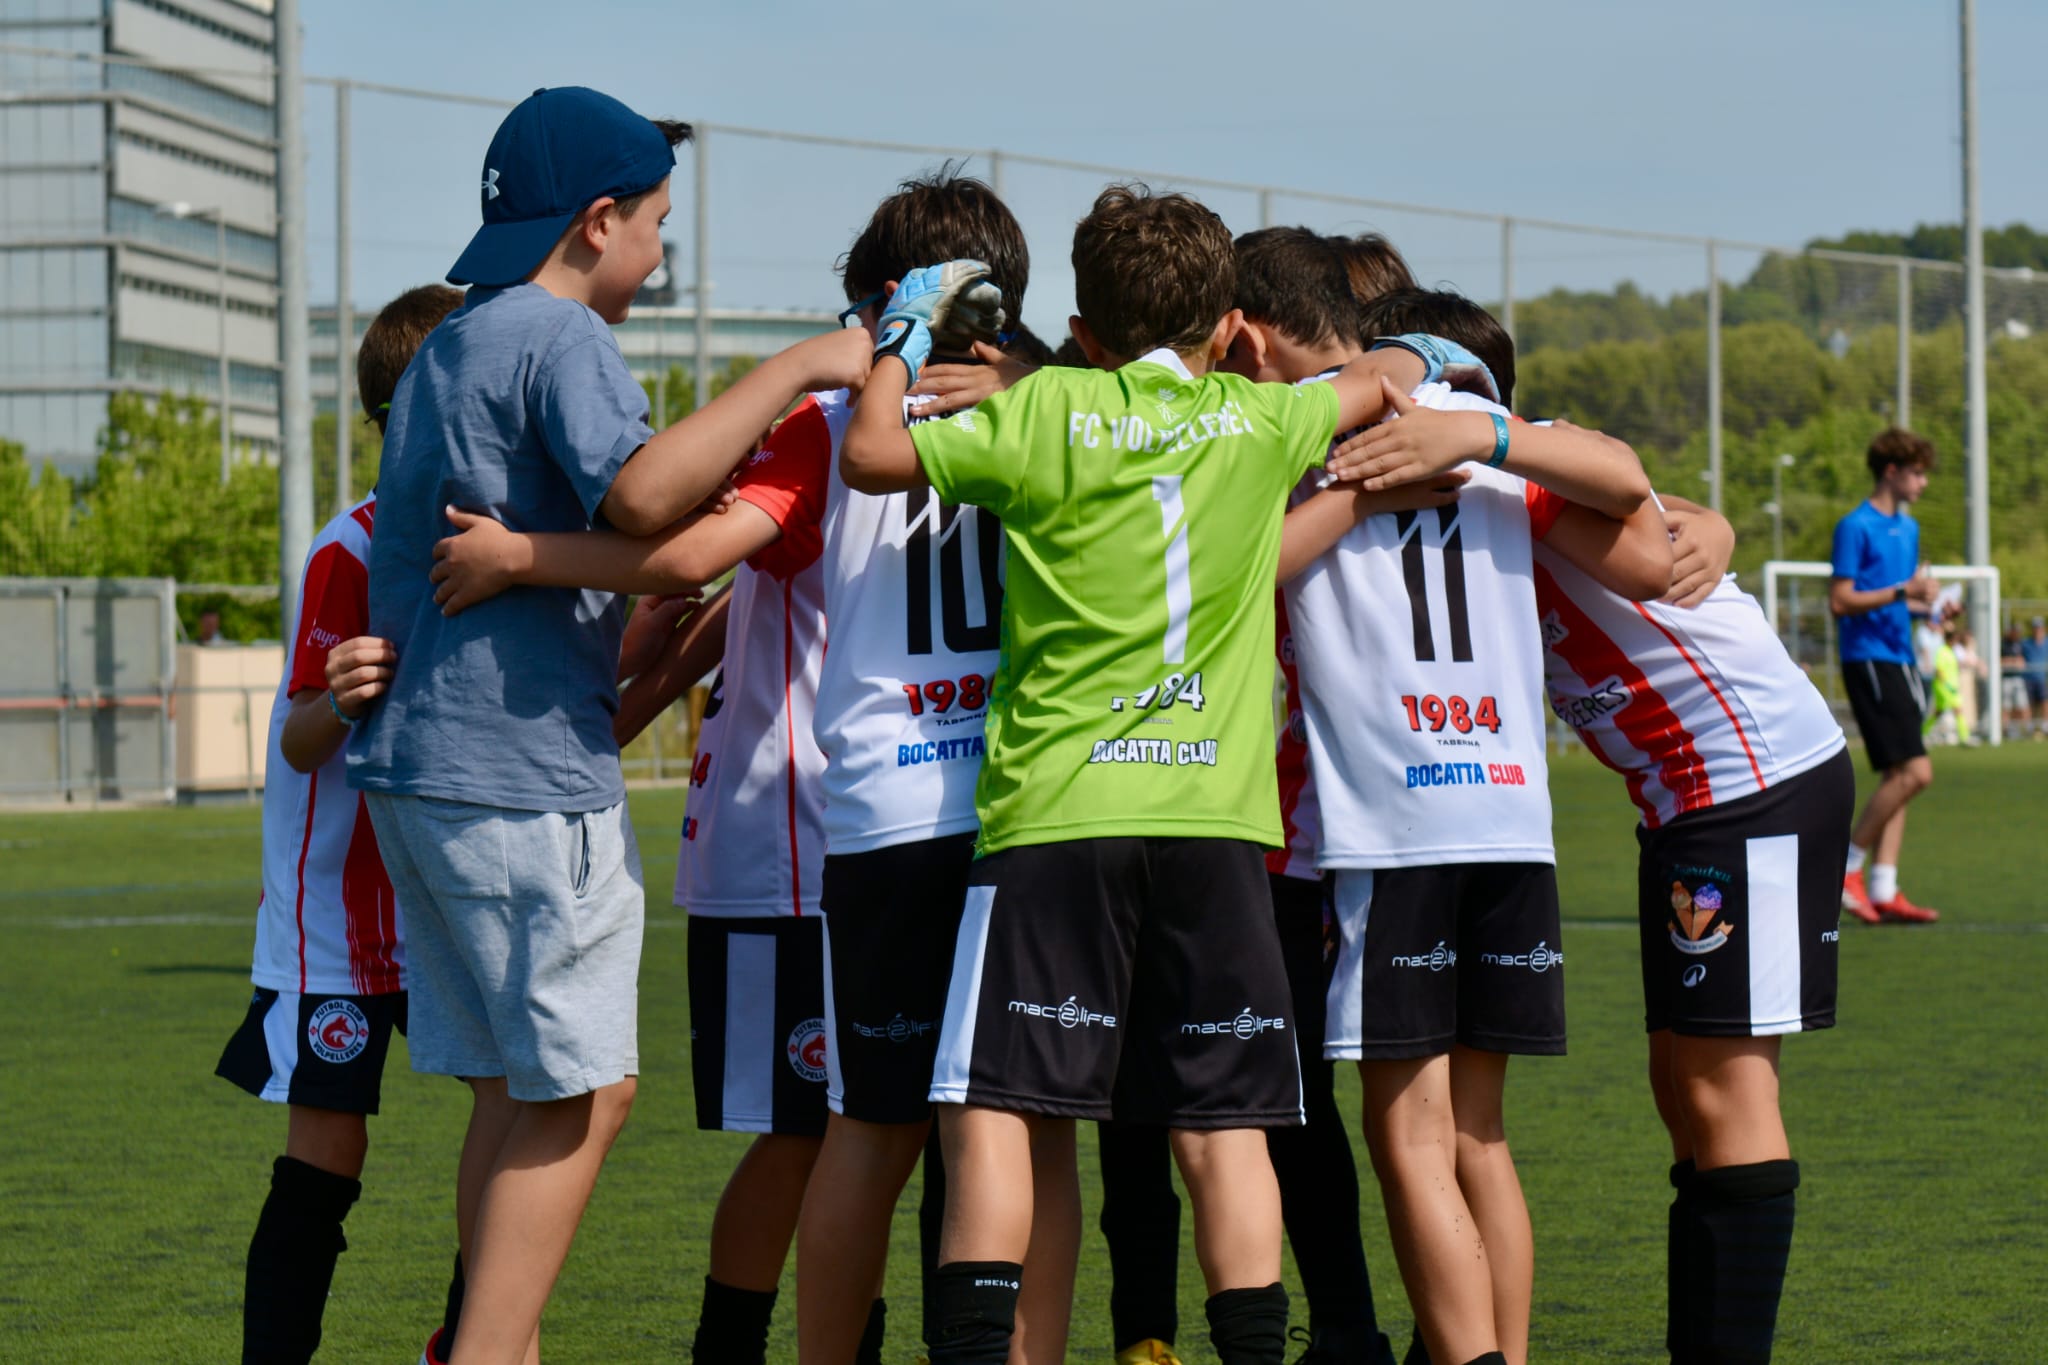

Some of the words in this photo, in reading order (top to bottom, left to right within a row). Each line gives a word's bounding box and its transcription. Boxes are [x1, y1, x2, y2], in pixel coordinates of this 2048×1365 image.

[1069, 411, 1101, 449] FC
[905, 485, 1004, 655] 10
[1151, 475, 1192, 664] 1
[1392, 500, 1474, 662] 11
[902, 673, 995, 716] 198
[1401, 694, 1502, 734] 1984
[897, 735, 985, 767] BOCATTA
[1436, 738, 1481, 748] TABERNA
[1405, 762, 1486, 789] BOCATTA
[1487, 763, 1526, 786] CLUB
[315, 1001, 345, 1020] FUTBOL
[313, 1041, 363, 1061] VOLPELLERES
